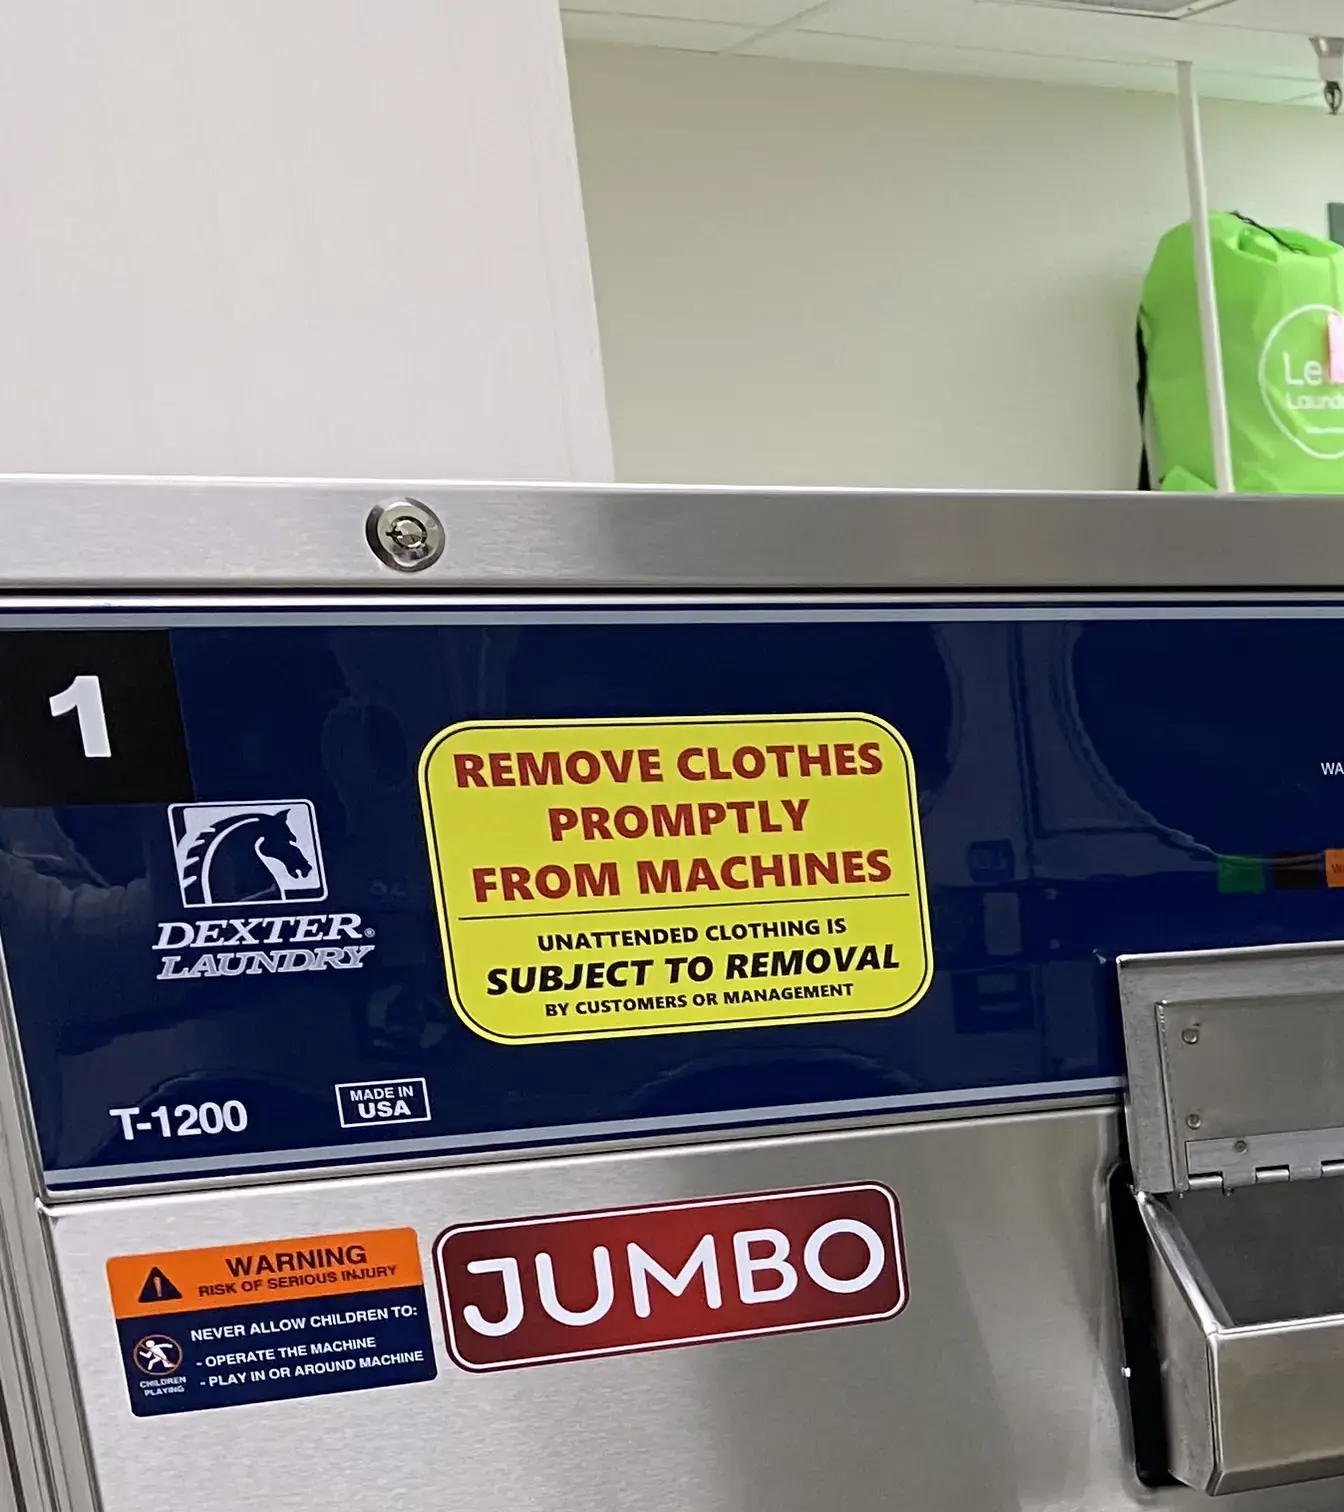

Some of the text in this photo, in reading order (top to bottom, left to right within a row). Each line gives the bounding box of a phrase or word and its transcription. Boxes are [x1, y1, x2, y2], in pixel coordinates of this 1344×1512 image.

[48, 675, 113, 758] 1
[453, 742, 883, 789] REMOVE CLOTHES
[548, 798, 810, 842] PROMPTLY
[472, 849, 892, 903] FROM MACHINES
[537, 917, 847, 952] UNATTENDED CLOTHING IS
[156, 944, 376, 980] LAUNDRY
[486, 943, 900, 996] SUBJECT TO REMOVAL
[545, 982, 854, 1017] BY CUSTOMERS OR MANAGEMENT
[349, 1085, 414, 1102] MADE IN
[357, 1099, 412, 1119] USA
[109, 1099, 248, 1141] T-1200
[224, 1244, 368, 1278] WARNING
[463, 1218, 885, 1337] JUMBO
[198, 1265, 396, 1298] RISK OF SERIOUS INJURY
[190, 1304, 418, 1342] NEVER ALLOW CHILDREN TO:
[205, 1336, 377, 1368] OPERATE THE MACHINE
[208, 1350, 425, 1387] PLAY IN OR AROUND MACHINE
